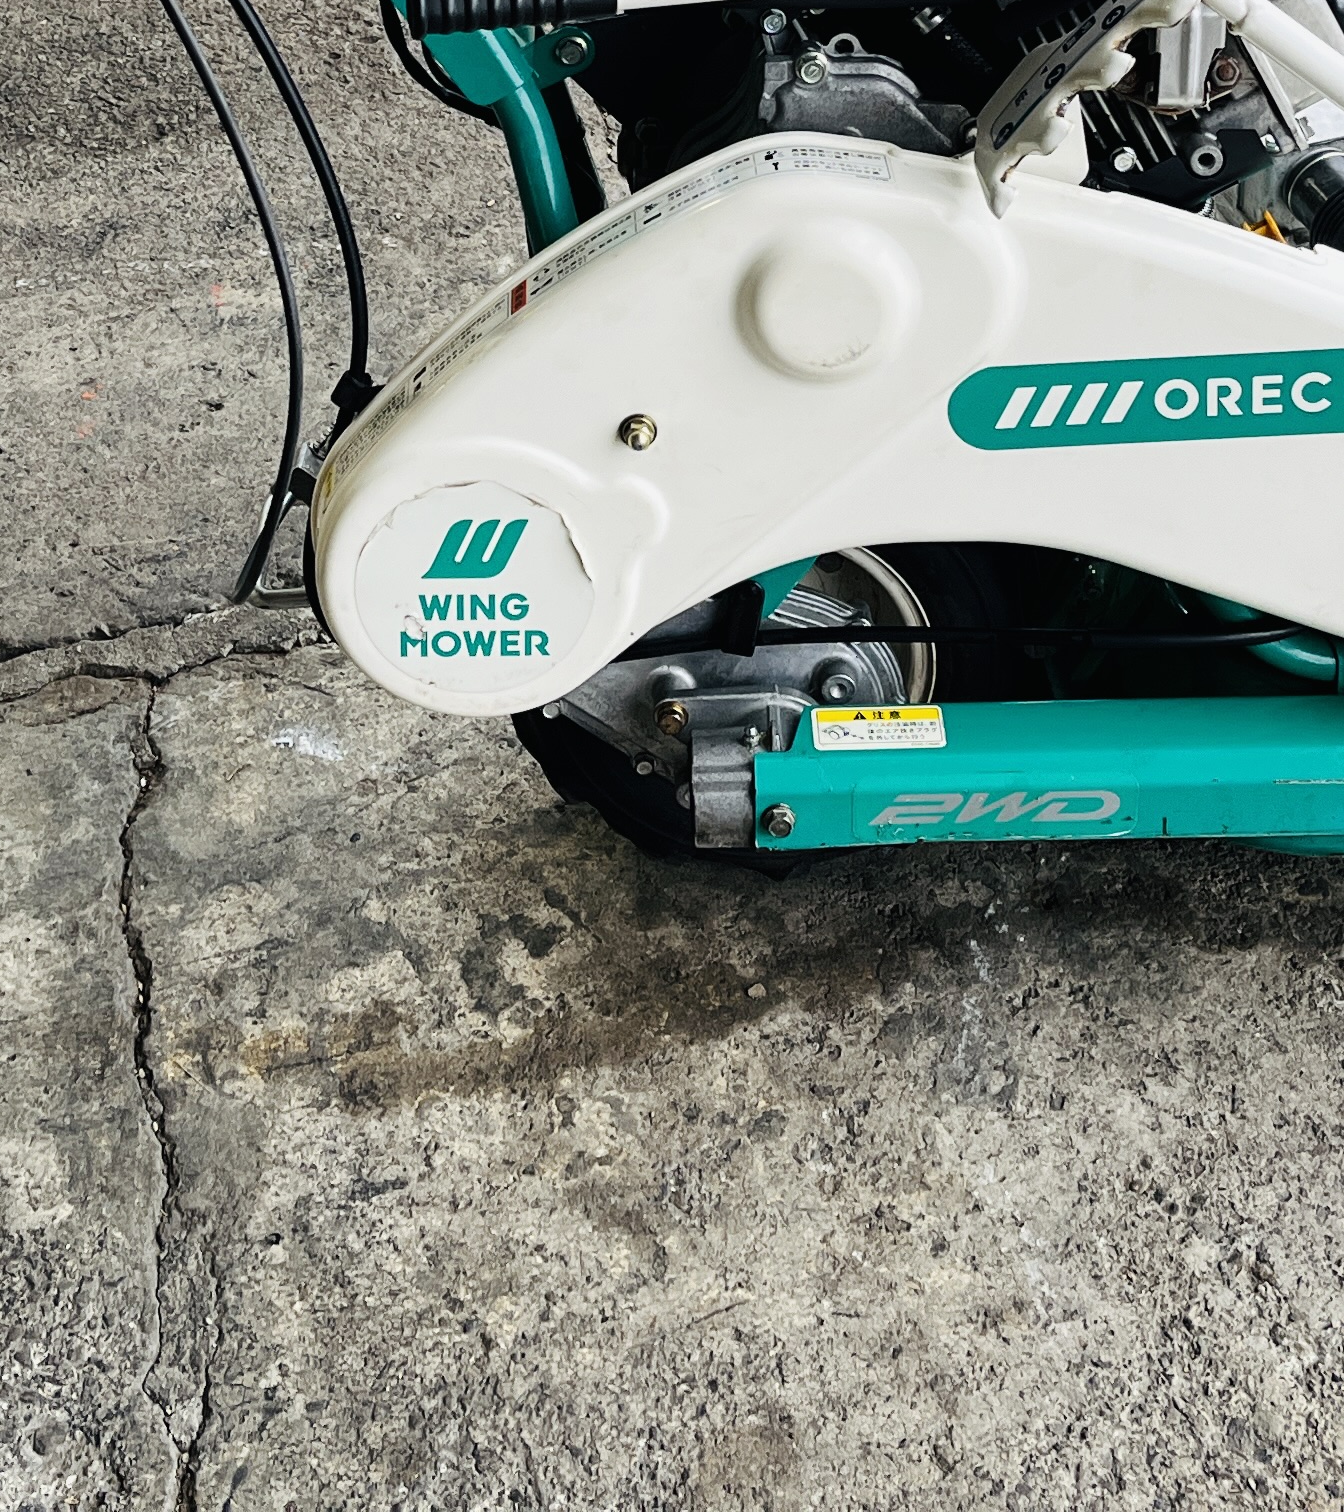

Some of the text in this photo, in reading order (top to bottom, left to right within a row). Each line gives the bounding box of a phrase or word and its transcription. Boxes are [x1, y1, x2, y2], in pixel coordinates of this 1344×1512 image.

[1154, 371, 1333, 420] OREC
[418, 593, 530, 621] WING
[400, 630, 551, 658] MOWER
[872, 710, 901, 720] 注意
[868, 790, 1121, 826] 2WD
